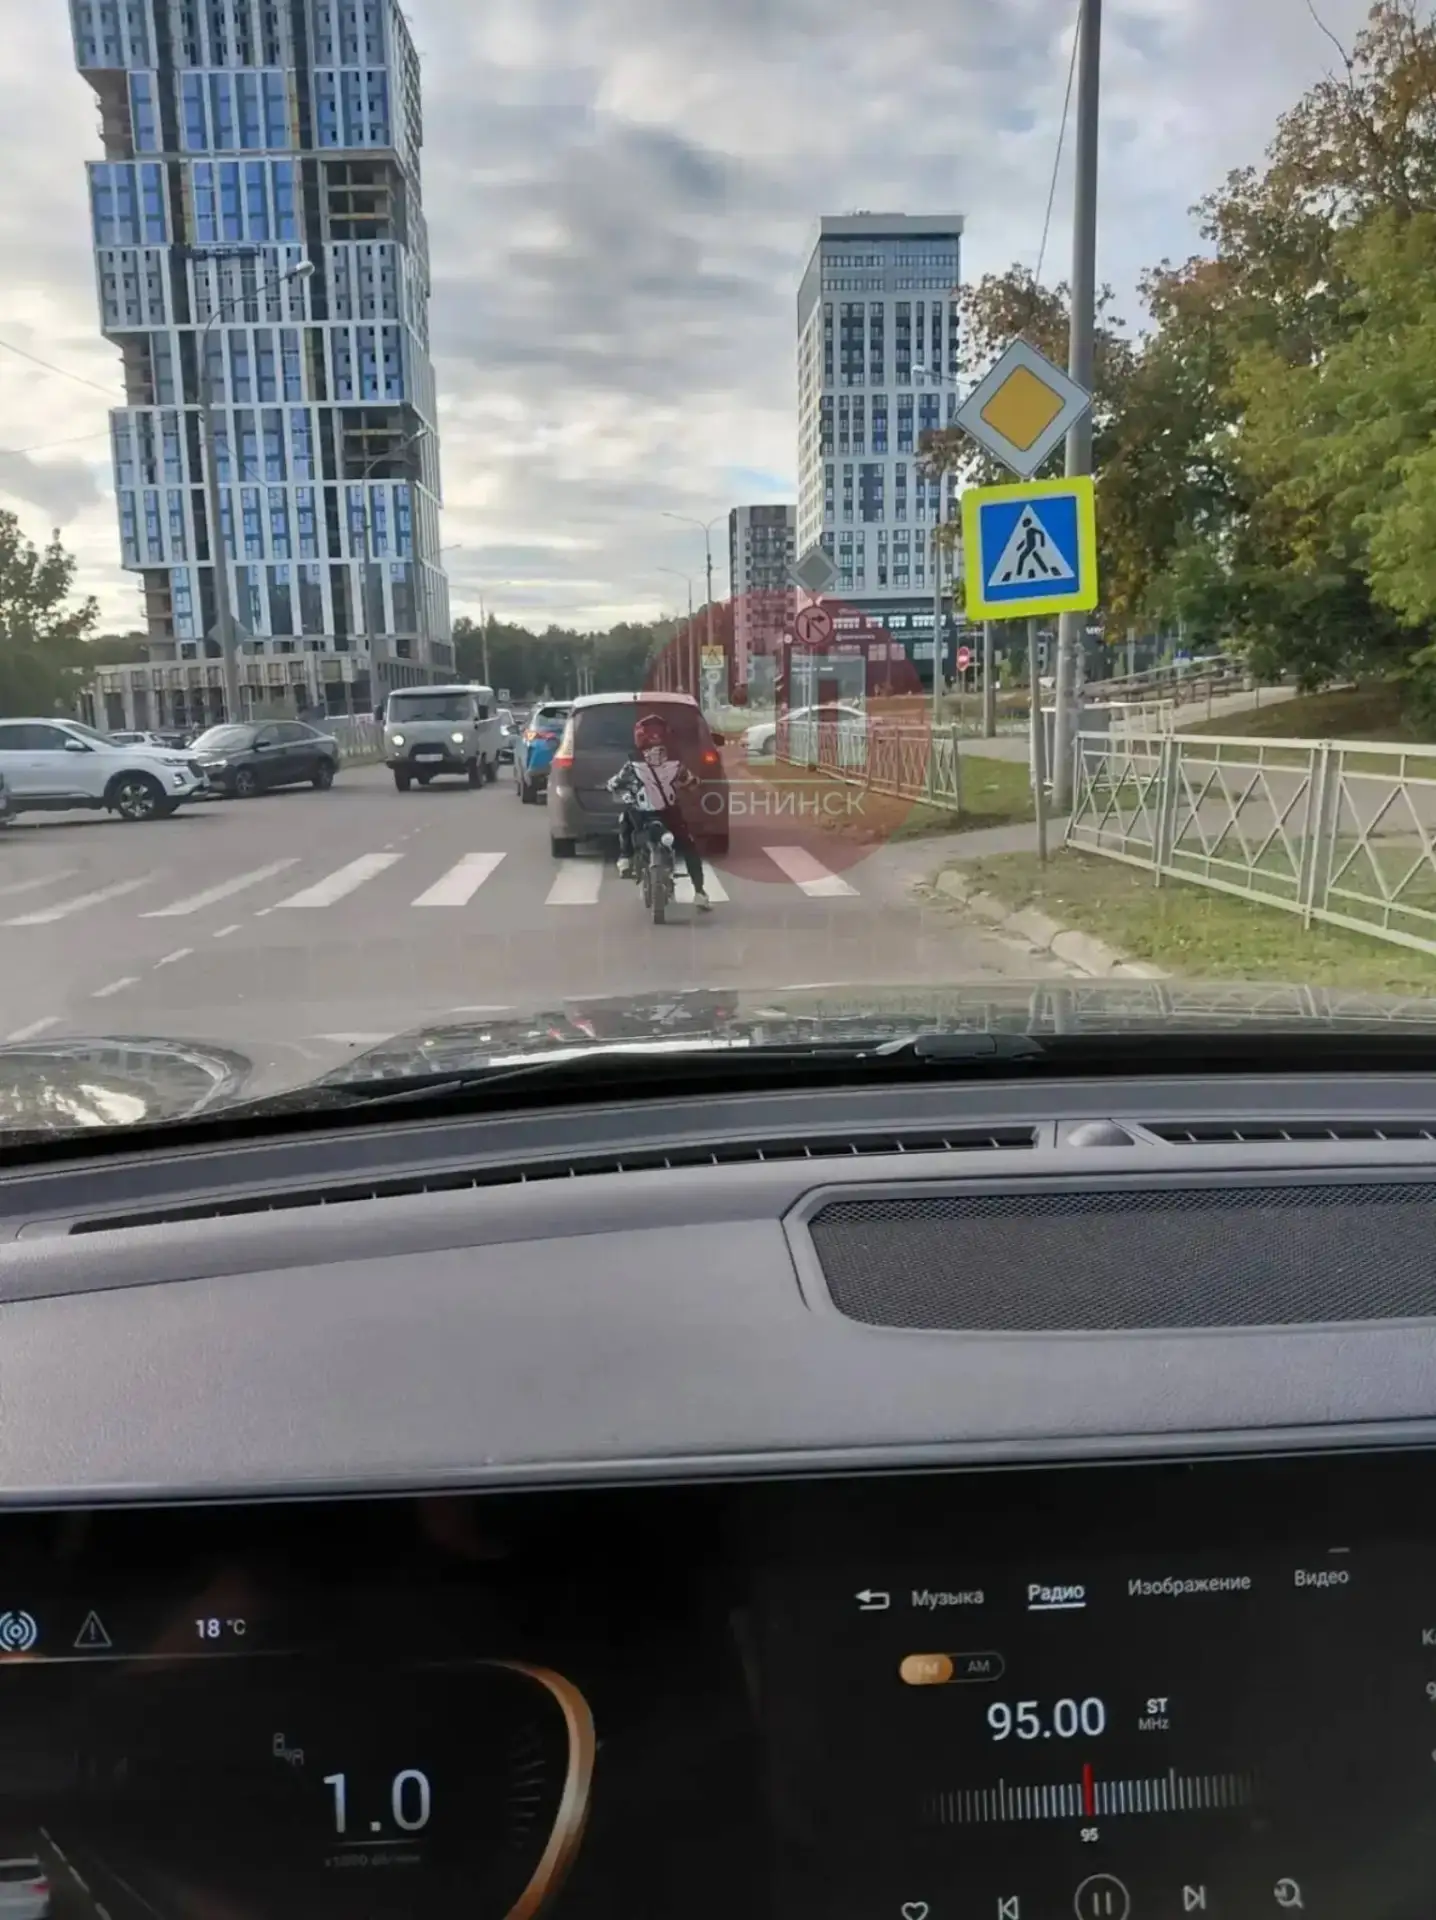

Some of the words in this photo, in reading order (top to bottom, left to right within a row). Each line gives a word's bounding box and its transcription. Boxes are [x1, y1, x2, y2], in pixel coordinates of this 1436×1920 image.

[1127, 1575, 1252, 1598] Изображение
[1294, 1569, 1350, 1588] Видео
[911, 1589, 985, 1610] Музыка
[1027, 1583, 1086, 1604] Радио
[195, 1618, 221, 1639] 18
[967, 1659, 990, 1673] AM
[1146, 1698, 1169, 1714] ST
[987, 1697, 1106, 1741] 95.00
[1138, 1716, 1169, 1731] MHz
[323, 1769, 431, 1833] 1.0
[1080, 1827, 1099, 1843] 95
